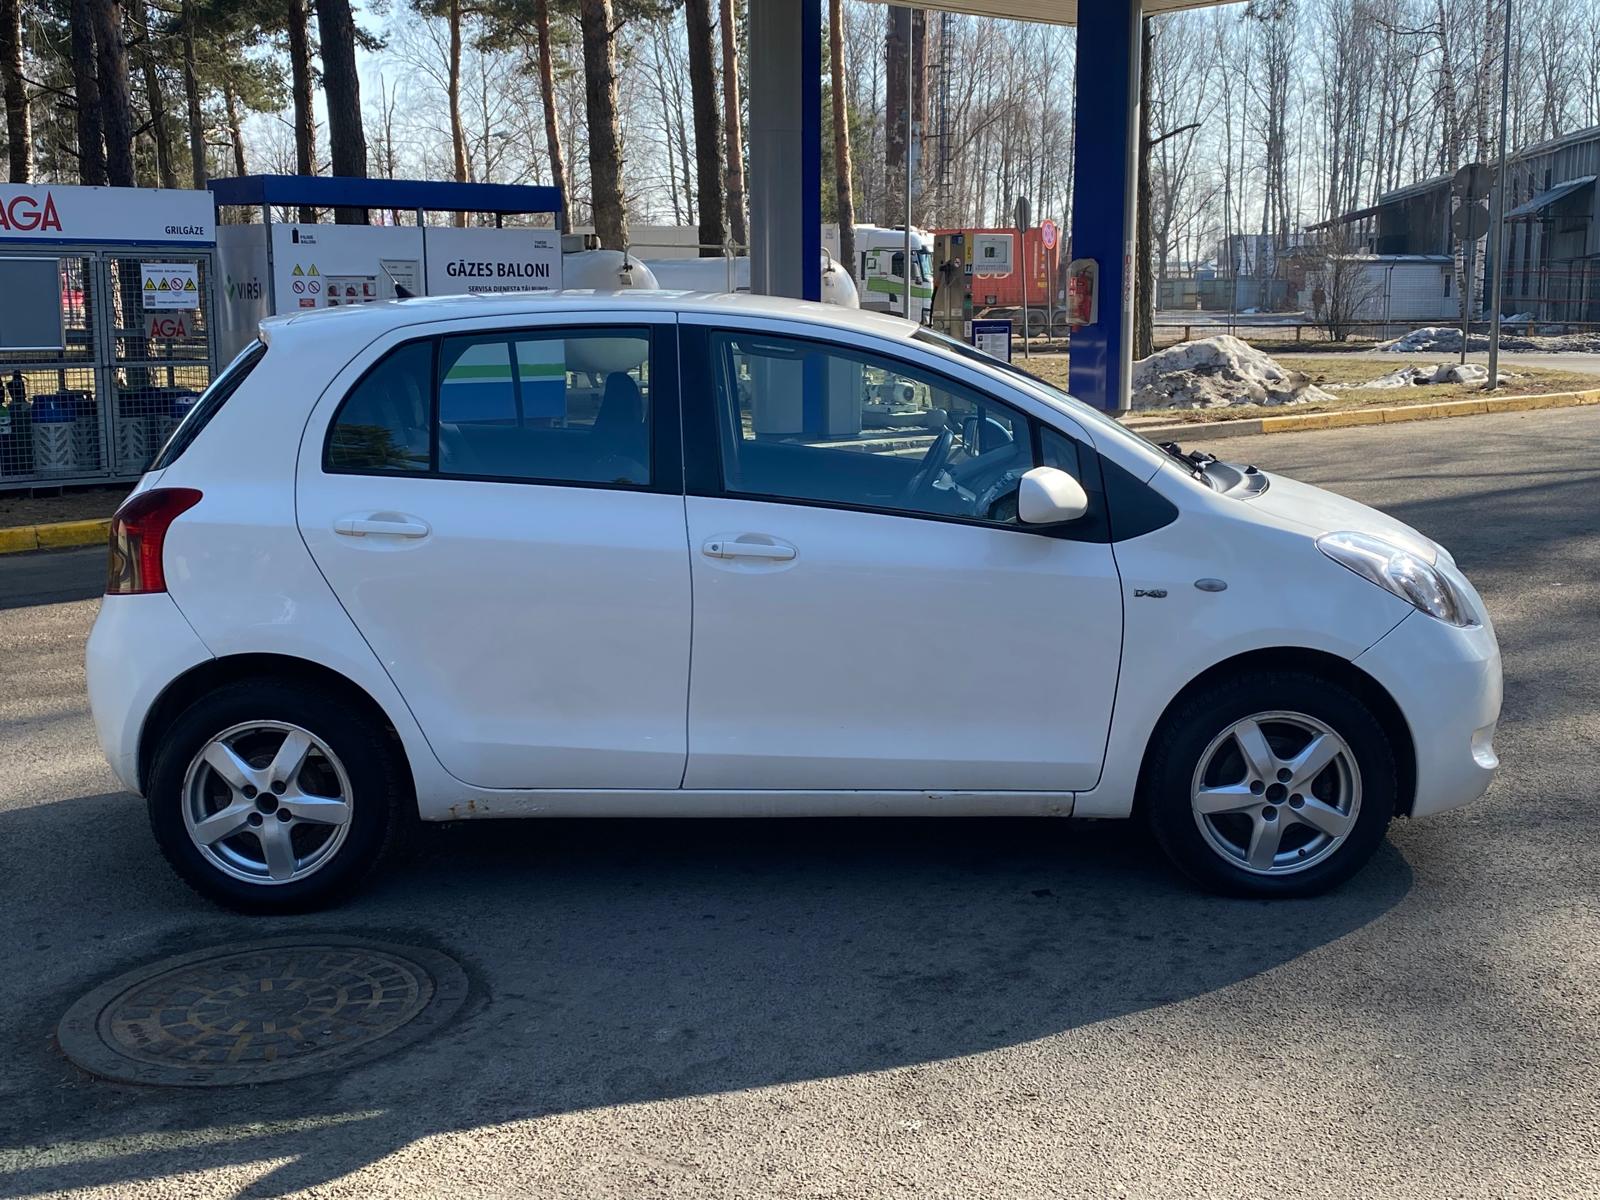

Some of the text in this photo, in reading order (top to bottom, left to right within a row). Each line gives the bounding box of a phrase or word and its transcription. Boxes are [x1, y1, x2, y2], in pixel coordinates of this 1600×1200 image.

[446, 259, 550, 278] GĀZES BALONI
[237, 277, 262, 300] VIRŠI
[151, 317, 186, 337] AGA
